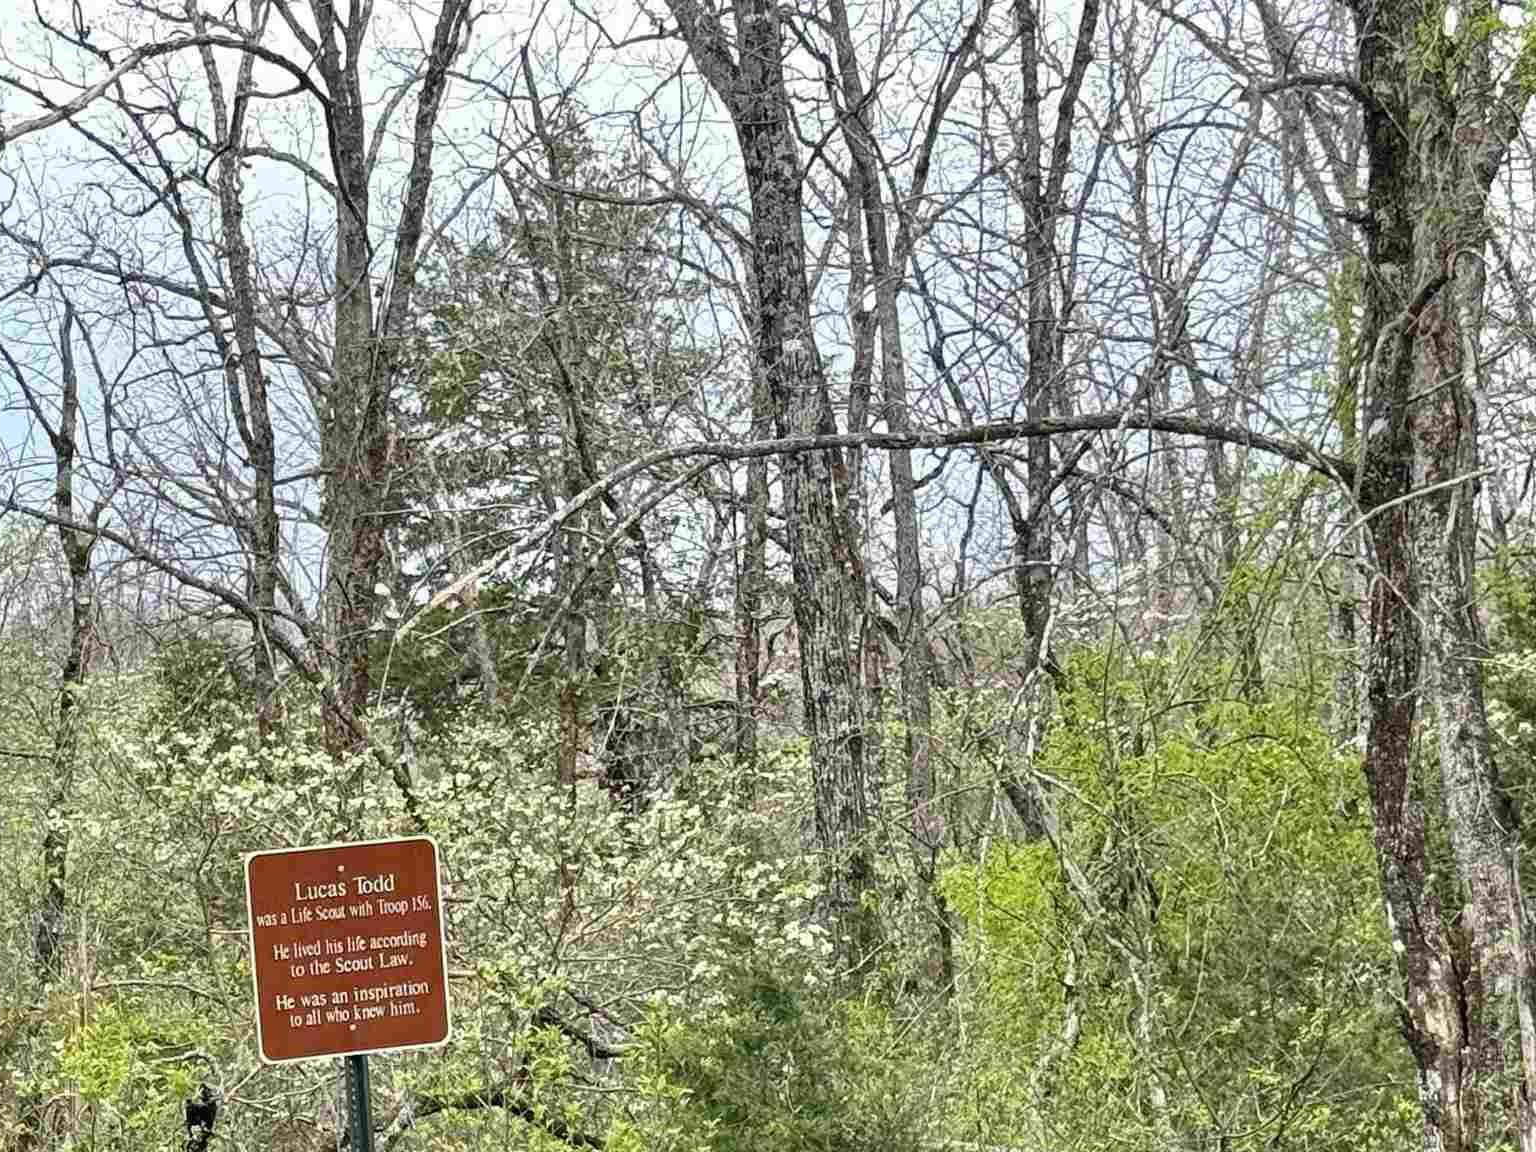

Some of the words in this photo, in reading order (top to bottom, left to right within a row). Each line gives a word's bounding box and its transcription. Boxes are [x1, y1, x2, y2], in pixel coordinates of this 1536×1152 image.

[295, 882, 347, 901] Lucas
[353, 873, 395, 895] Todd
[256, 912, 277, 927] was
[280, 911, 287, 924] a
[291, 907, 313, 924] Life
[315, 904, 346, 921] Scout
[350, 901, 373, 917] with
[379, 898, 409, 915] Troop
[412, 896, 432, 911] 156.
[273, 944, 289, 960] He
[294, 940, 321, 957] lived
[326, 938, 344, 955] his
[348, 935, 367, 952] life
[370, 930, 427, 950] according
[291, 964, 305, 978] to
[310, 959, 331, 976] the
[335, 955, 374, 974] Scout
[380, 951, 413, 968] Law.
[276, 995, 295, 1011] He
[301, 992, 327, 1008] was
[332, 992, 348, 1004] an
[353, 981, 430, 1003] inspiration
[290, 1013, 302, 1027] to
[306, 1009, 321, 1025] all
[326, 1006, 350, 1023] who
[354, 1004, 385, 1021] knew
[390, 1001, 420, 1017] him.
